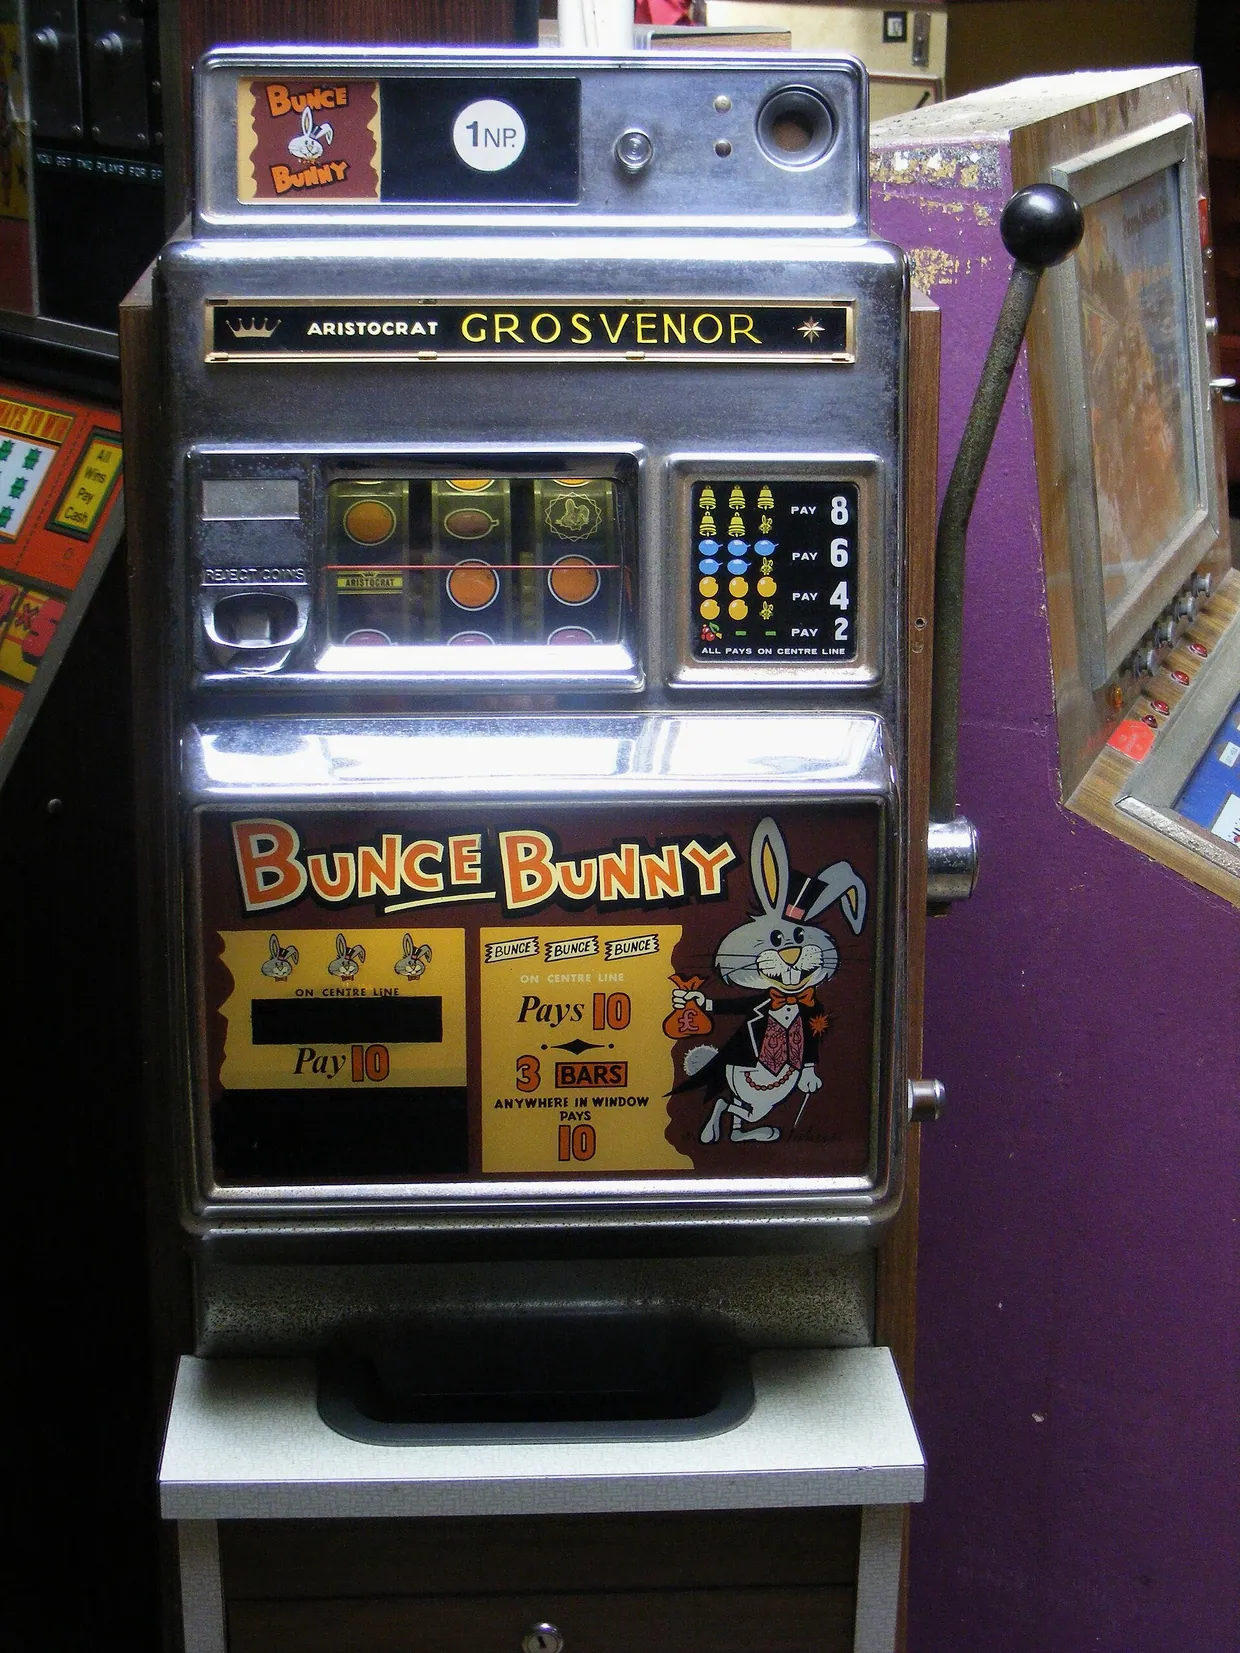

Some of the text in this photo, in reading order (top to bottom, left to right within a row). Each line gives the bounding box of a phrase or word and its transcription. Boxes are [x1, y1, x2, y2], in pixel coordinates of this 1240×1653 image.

[266, 83, 349, 118] BUNCE
[270, 159, 349, 195] BUNNY
[307, 321, 438, 336] ARISTOCRAT
[461, 312, 762, 346] GROSVENOR
[97, 449, 113, 464] All
[84, 466, 107, 484] Wins
[77, 487, 94, 505] Pay
[64, 506, 88, 525] Cash
[791, 496, 849, 526] PAY 8
[792, 538, 849, 568] PAY 6
[205, 568, 305, 581] REJECT COINS
[345, 576, 395, 588] ARISTOCRAT
[792, 581, 850, 611] PAY 4
[791, 617, 849, 641] PAY 2
[701, 647, 846, 655] ALL PAYS ON CENTRE LINE
[231, 818, 736, 912] BUNCE BUNNY
[494, 939, 651, 958] BUNCE BUNCE BUNCE
[520, 972, 625, 984] ON CENTRE LINE
[295, 988, 315, 997] ON
[322, 987, 366, 997] CENTRE
[517, 992, 631, 1031] Pays 10
[293, 1044, 390, 1083] Pay 10
[516, 1054, 622, 1093] 3 BARS
[494, 1096, 650, 1109] ANYWHERE IN WINDOW
[559, 1110, 592, 1121] PAYS
[558, 1123, 597, 1162] 10
